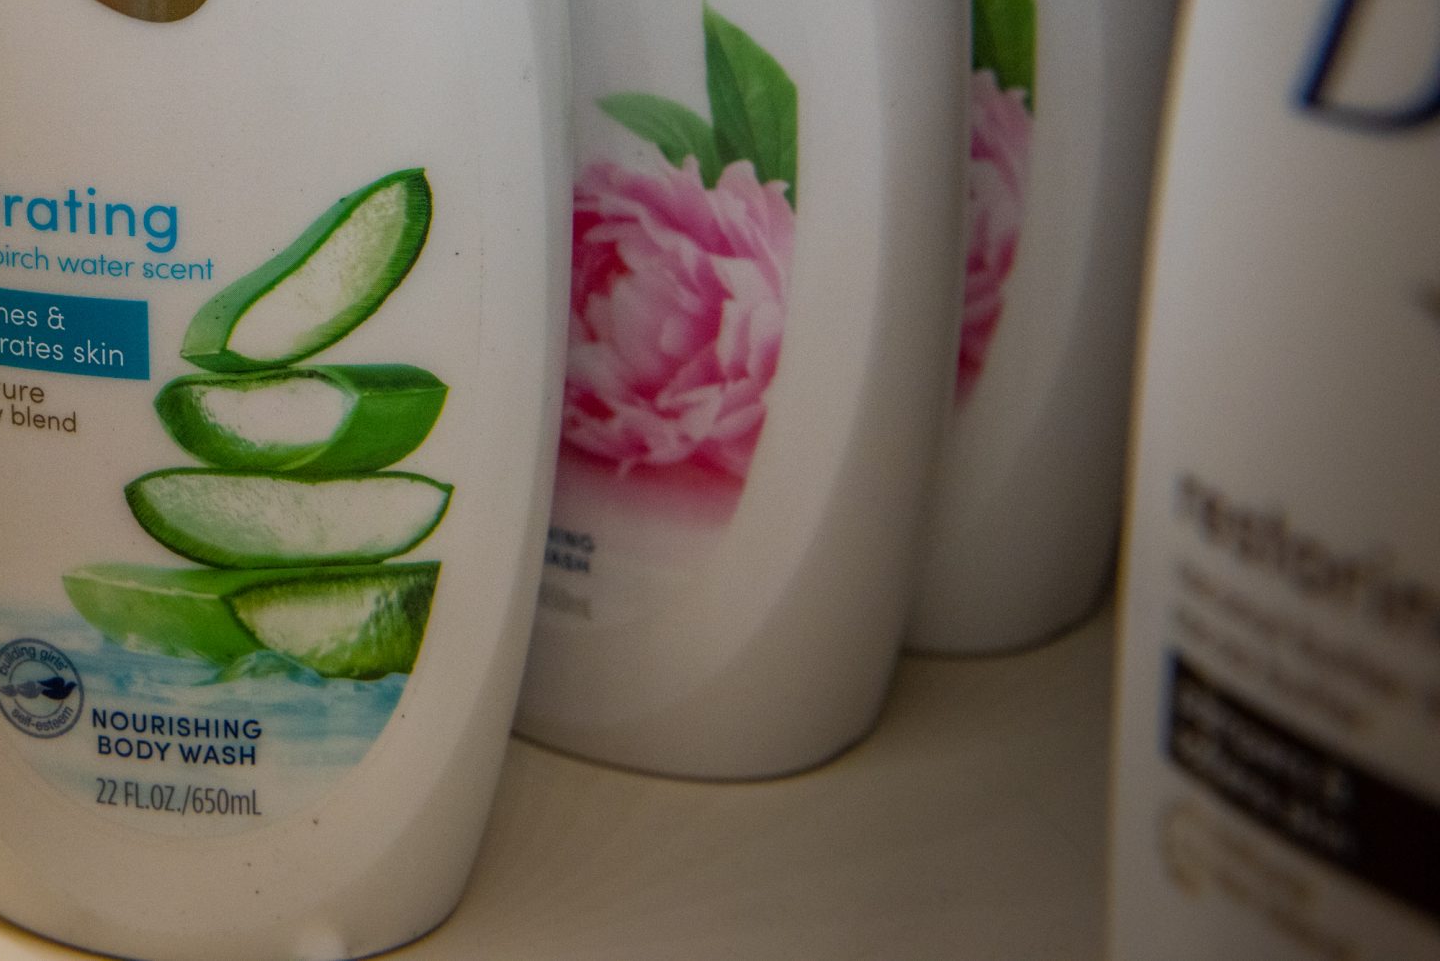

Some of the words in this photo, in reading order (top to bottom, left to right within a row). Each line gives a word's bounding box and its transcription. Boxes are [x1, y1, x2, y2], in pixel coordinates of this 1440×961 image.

[57, 255, 133, 279] water
[143, 258, 214, 280] scent
[47, 306, 65, 330] &
[73, 339, 124, 367] skin
[11, 406, 77, 433] blend
[11, 706, 74, 731] self-esteem
[92, 708, 262, 740] NOURISHING
[98, 735, 170, 761] BODY
[179, 743, 256, 765] WASH
[96, 778, 117, 806] 22
[124, 781, 262, 816] FL.OZ./650mL
